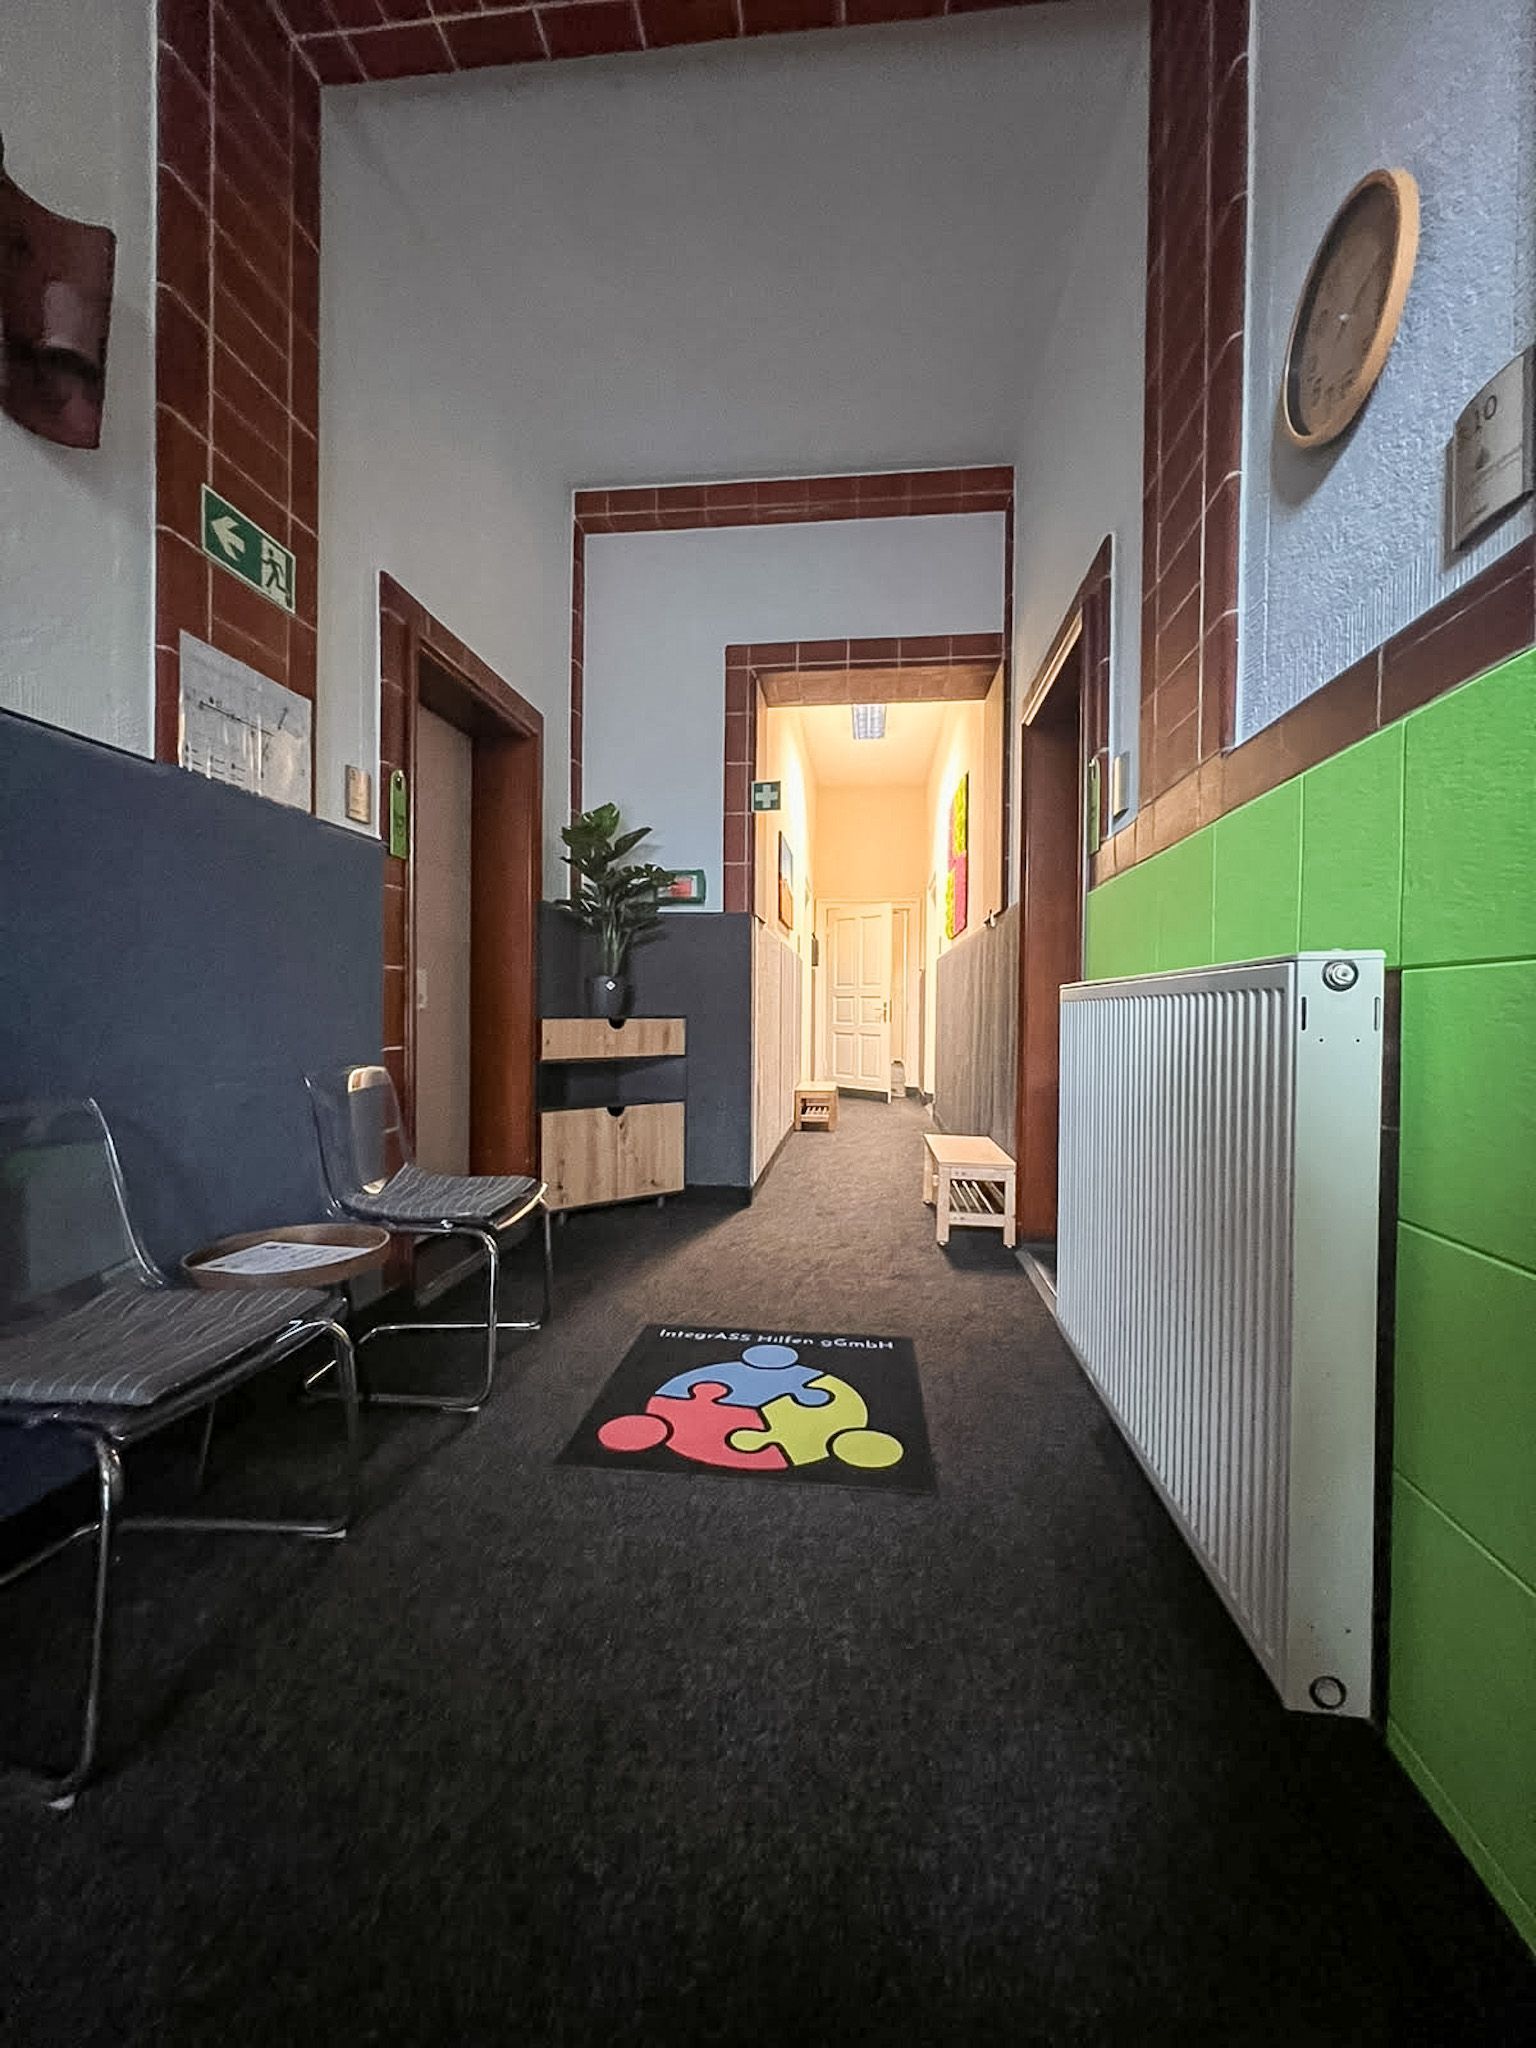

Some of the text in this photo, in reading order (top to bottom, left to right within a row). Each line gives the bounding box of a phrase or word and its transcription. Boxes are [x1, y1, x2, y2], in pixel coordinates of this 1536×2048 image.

[659, 1328, 894, 1350] IntegrASS Hilfen gGmbH
